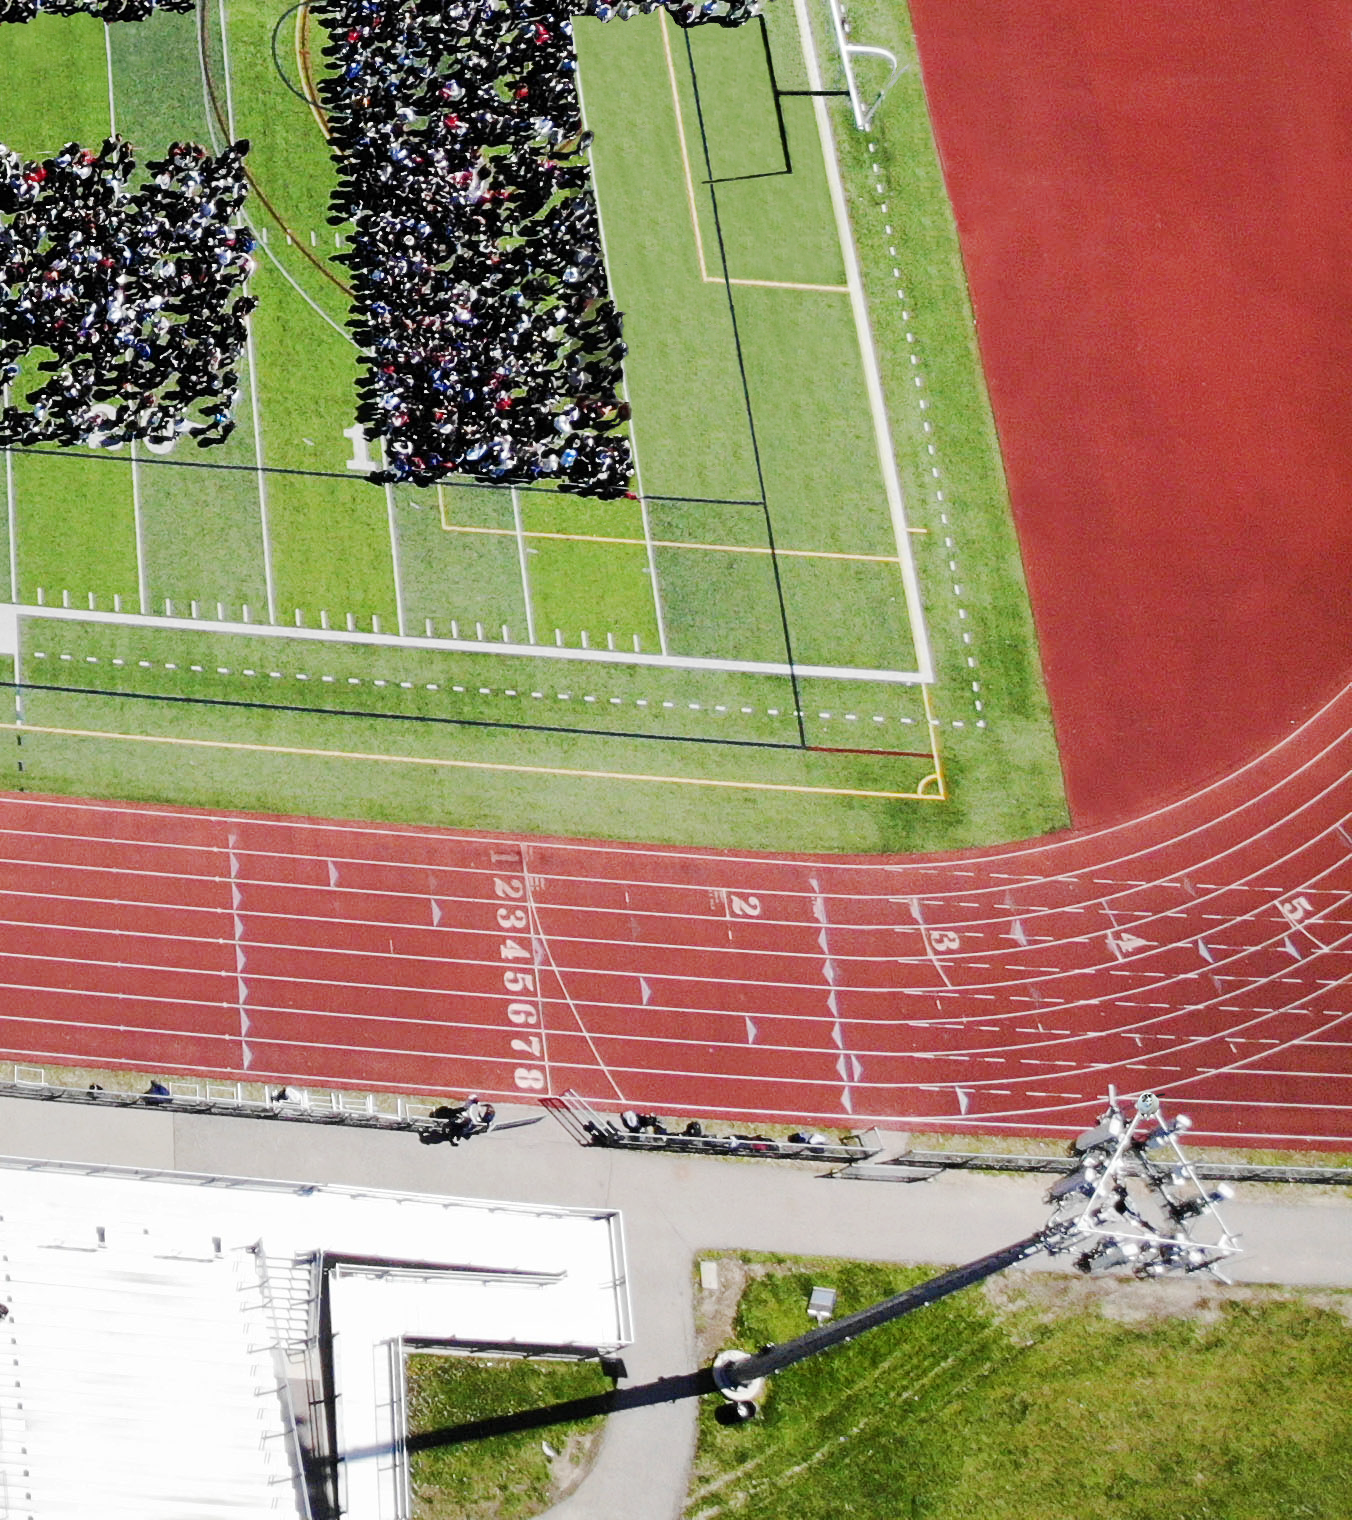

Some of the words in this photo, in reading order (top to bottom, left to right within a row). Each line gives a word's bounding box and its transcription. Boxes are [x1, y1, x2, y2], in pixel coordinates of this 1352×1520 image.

[489, 849, 520, 864] 1
[493, 877, 524, 898] 2
[730, 894, 761, 916] 2
[1284, 895, 1313, 920] 5
[496, 907, 527, 929] 3
[499, 939, 531, 960] 4
[929, 930, 960, 952] 3
[1118, 932, 1147, 953] 4
[503, 970, 534, 992] 5
[507, 1002, 538, 1025] 6
[510, 1035, 541, 1057] 7
[513, 1067, 545, 1090] 8
